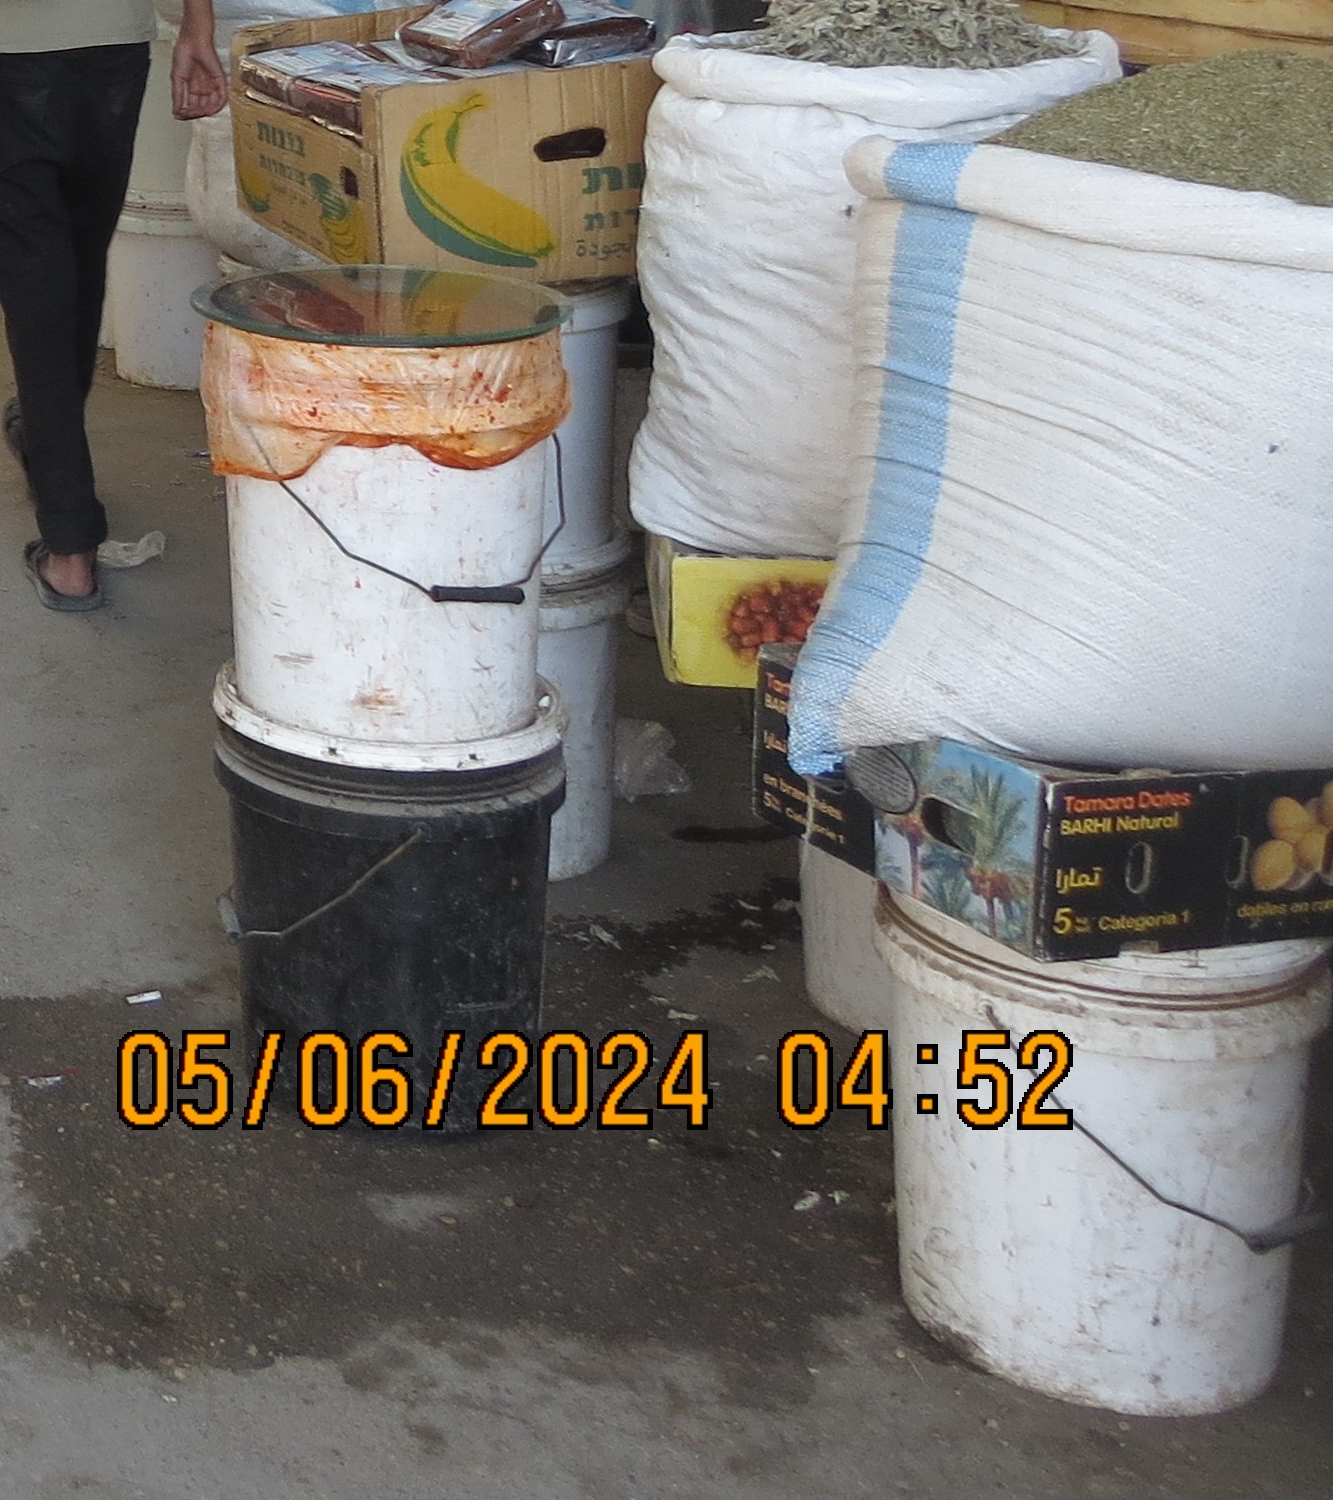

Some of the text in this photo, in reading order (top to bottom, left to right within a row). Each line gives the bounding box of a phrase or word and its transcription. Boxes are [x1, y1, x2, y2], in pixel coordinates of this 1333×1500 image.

[1064, 790, 1193, 814] Tamara Dates
[1060, 811, 1180, 837] BARHI Natural
[1055, 866, 1103, 895] تمارا
[1052, 907, 1073, 935] 5
